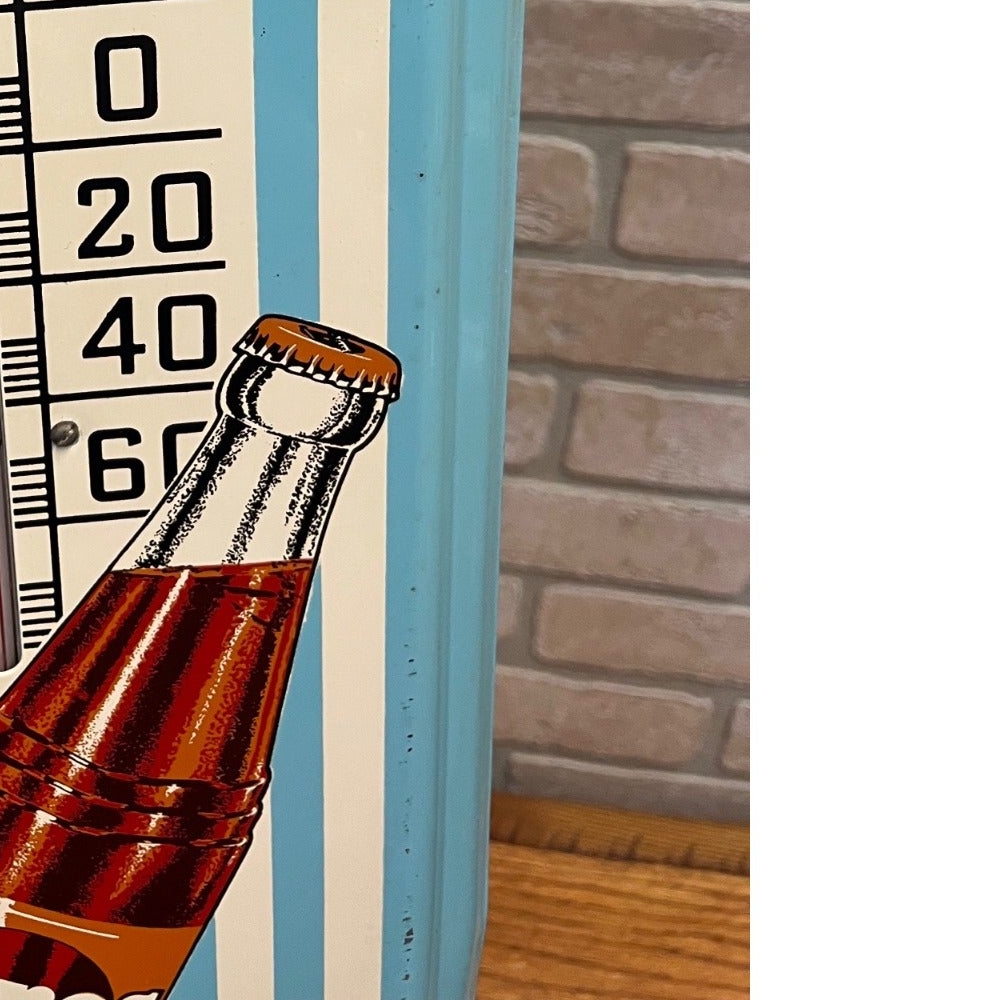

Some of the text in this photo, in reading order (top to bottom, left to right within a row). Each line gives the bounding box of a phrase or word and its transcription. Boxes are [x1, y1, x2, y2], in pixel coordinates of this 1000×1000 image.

[94, 34, 159, 122] 0
[77, 170, 213, 260] 20
[81, 293, 217, 375] 40
